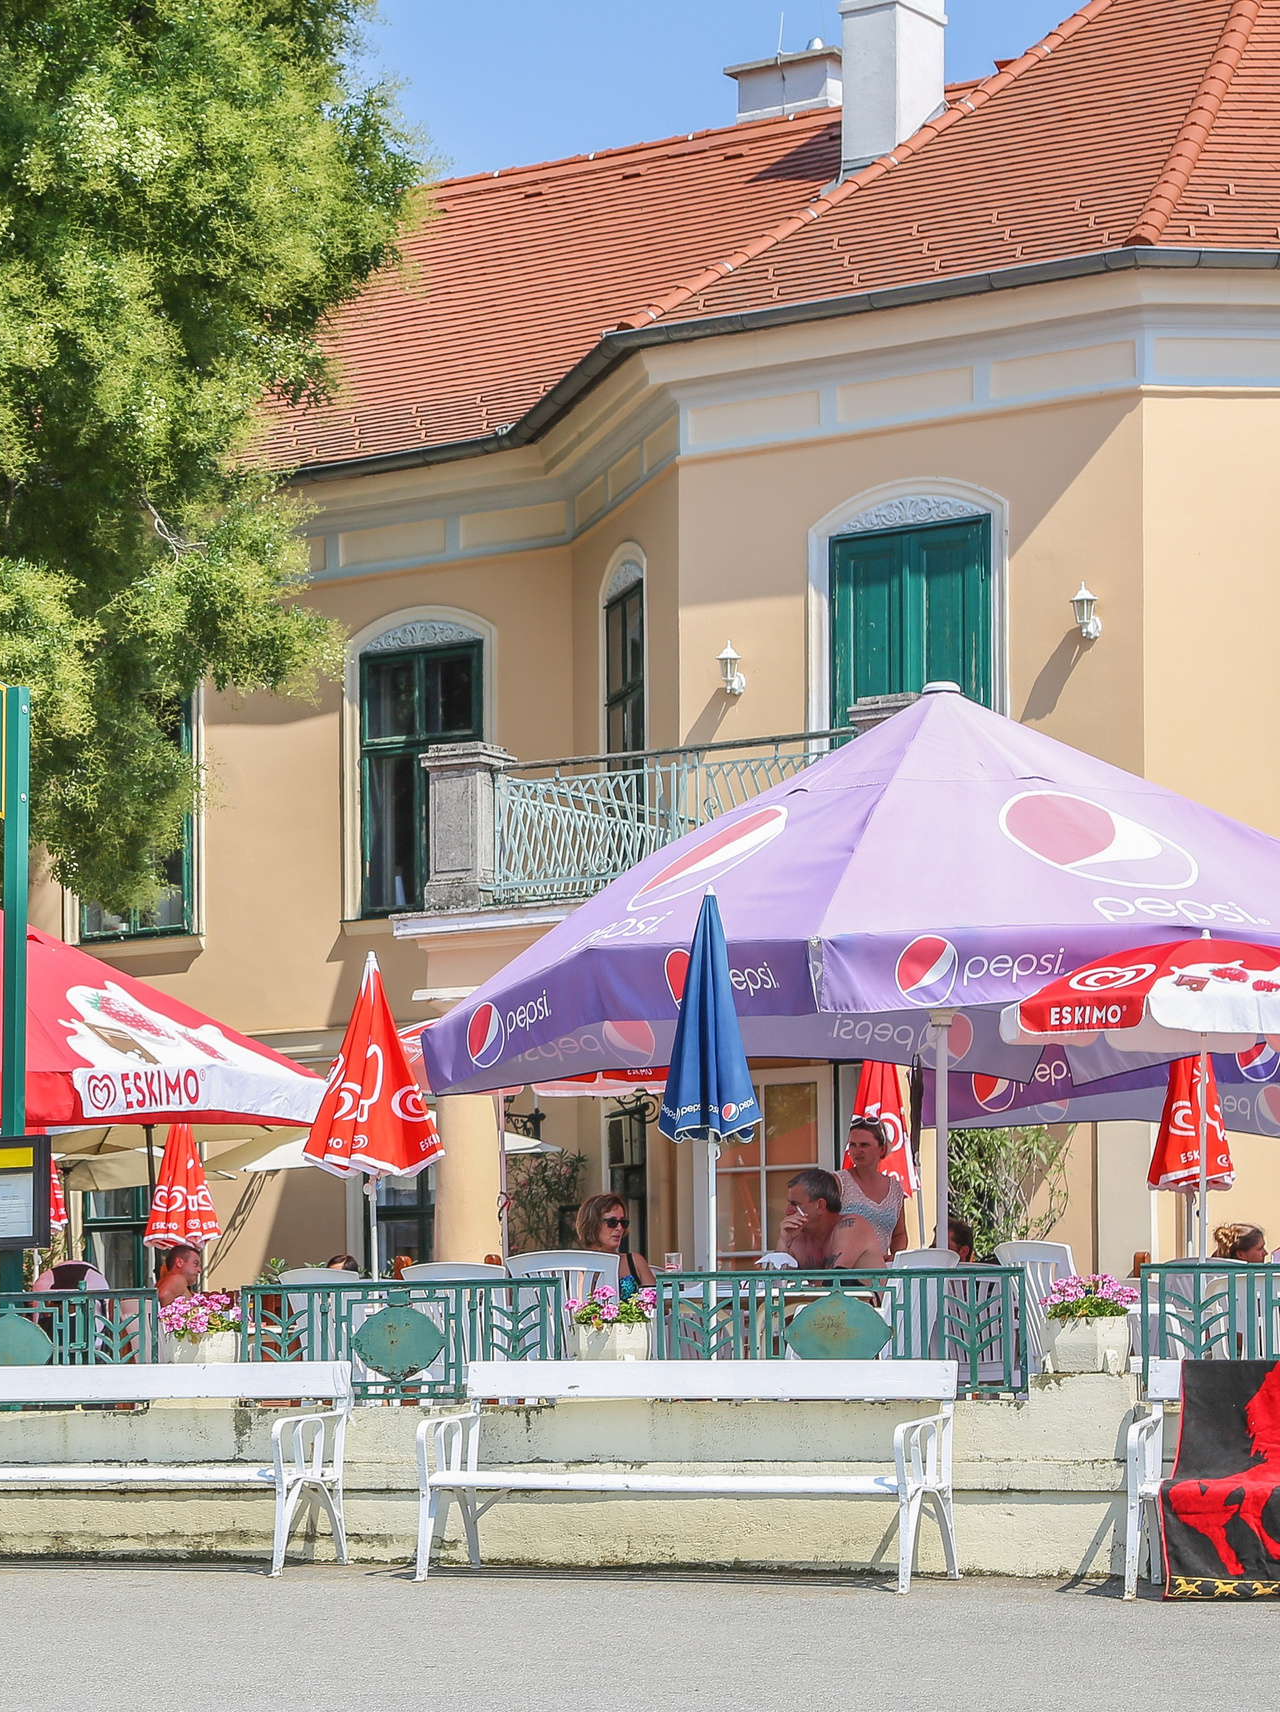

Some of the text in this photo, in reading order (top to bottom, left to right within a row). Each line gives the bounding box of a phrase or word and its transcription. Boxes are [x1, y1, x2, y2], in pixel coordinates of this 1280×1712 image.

[1092, 896, 1259, 924] pepsi
[558, 910, 674, 960] pepsi
[729, 961, 779, 996] epsi
[962, 947, 1066, 987] pepsi
[506, 989, 552, 1041] pepsi
[1050, 1004, 1122, 1026] ESKIMO
[121, 1068, 200, 1109] ESKIMO
